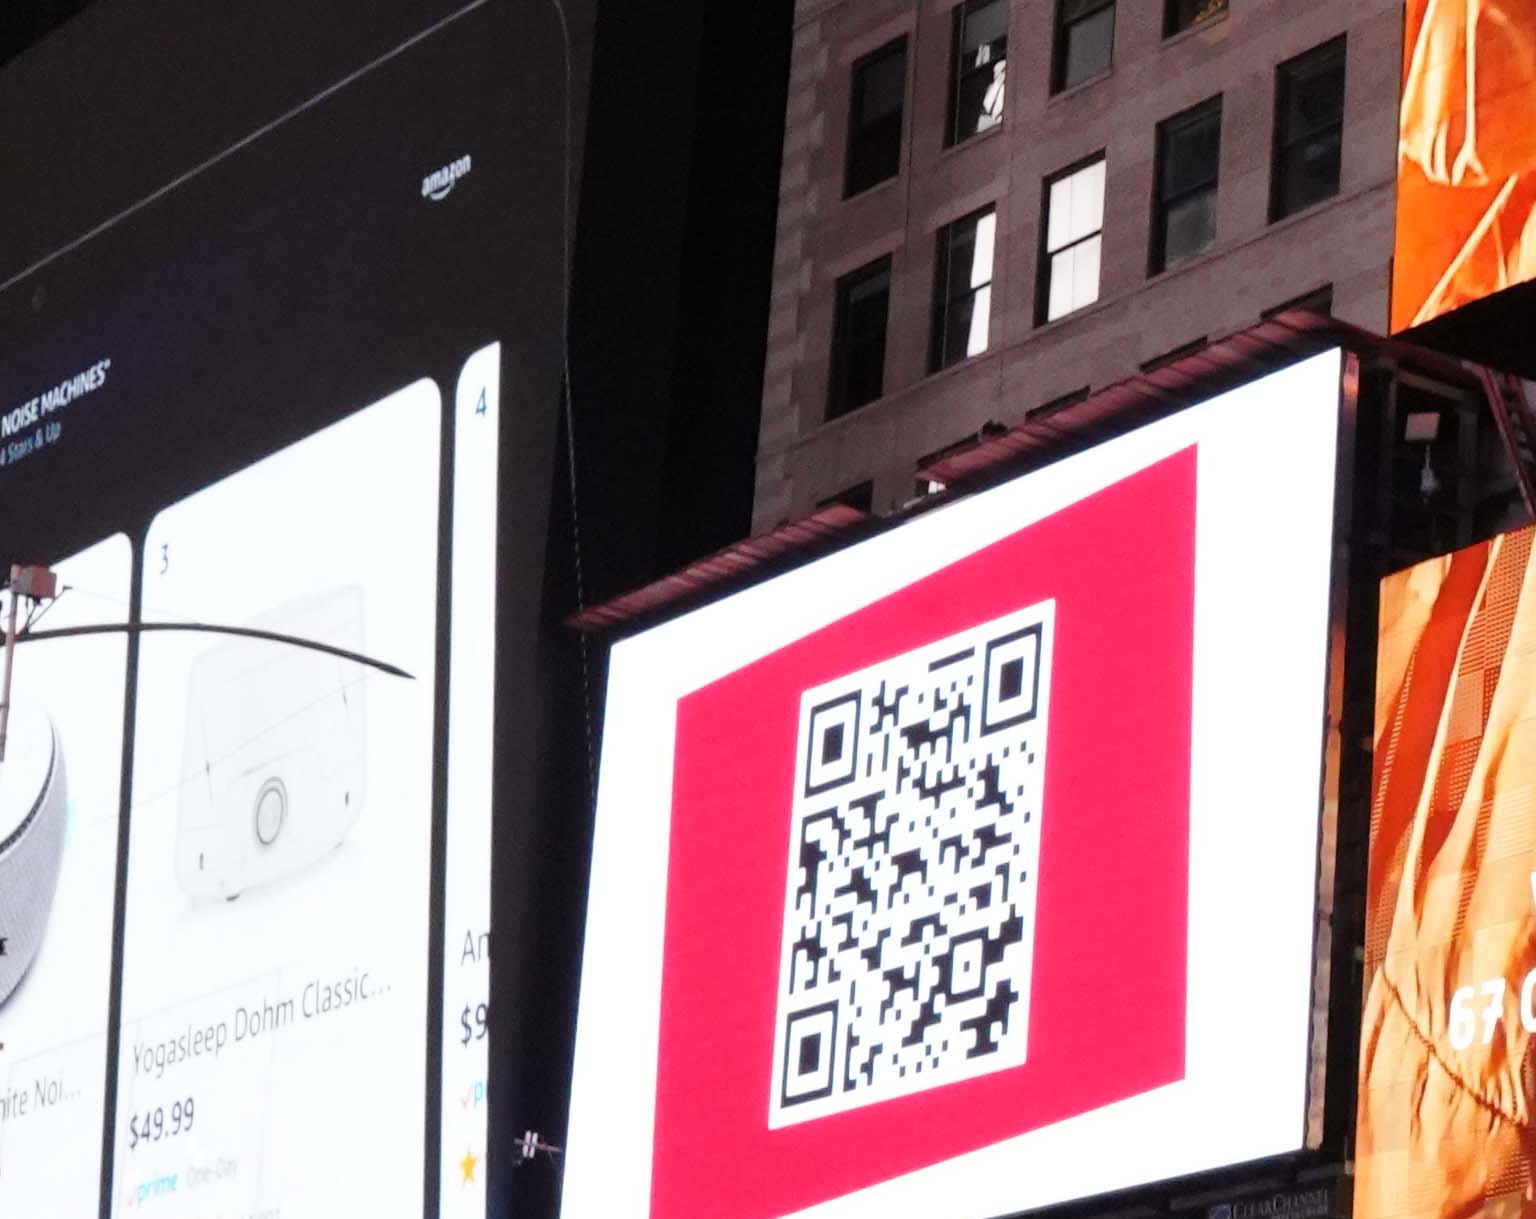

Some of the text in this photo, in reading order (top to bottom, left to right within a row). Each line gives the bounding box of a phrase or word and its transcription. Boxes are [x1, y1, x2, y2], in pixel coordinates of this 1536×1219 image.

[421, 153, 472, 200] amazon
[1, 397, 39, 438] NOISE
[474, 386, 487, 418] 4
[158, 542, 171, 575] 3
[1447, 976, 1507, 1052] 67
[133, 1019, 228, 1079] Yogasleep
[234, 996, 295, 1043] Dohm
[128, 1096, 195, 1151] $49.99
[137, 1172, 179, 1206] prime
